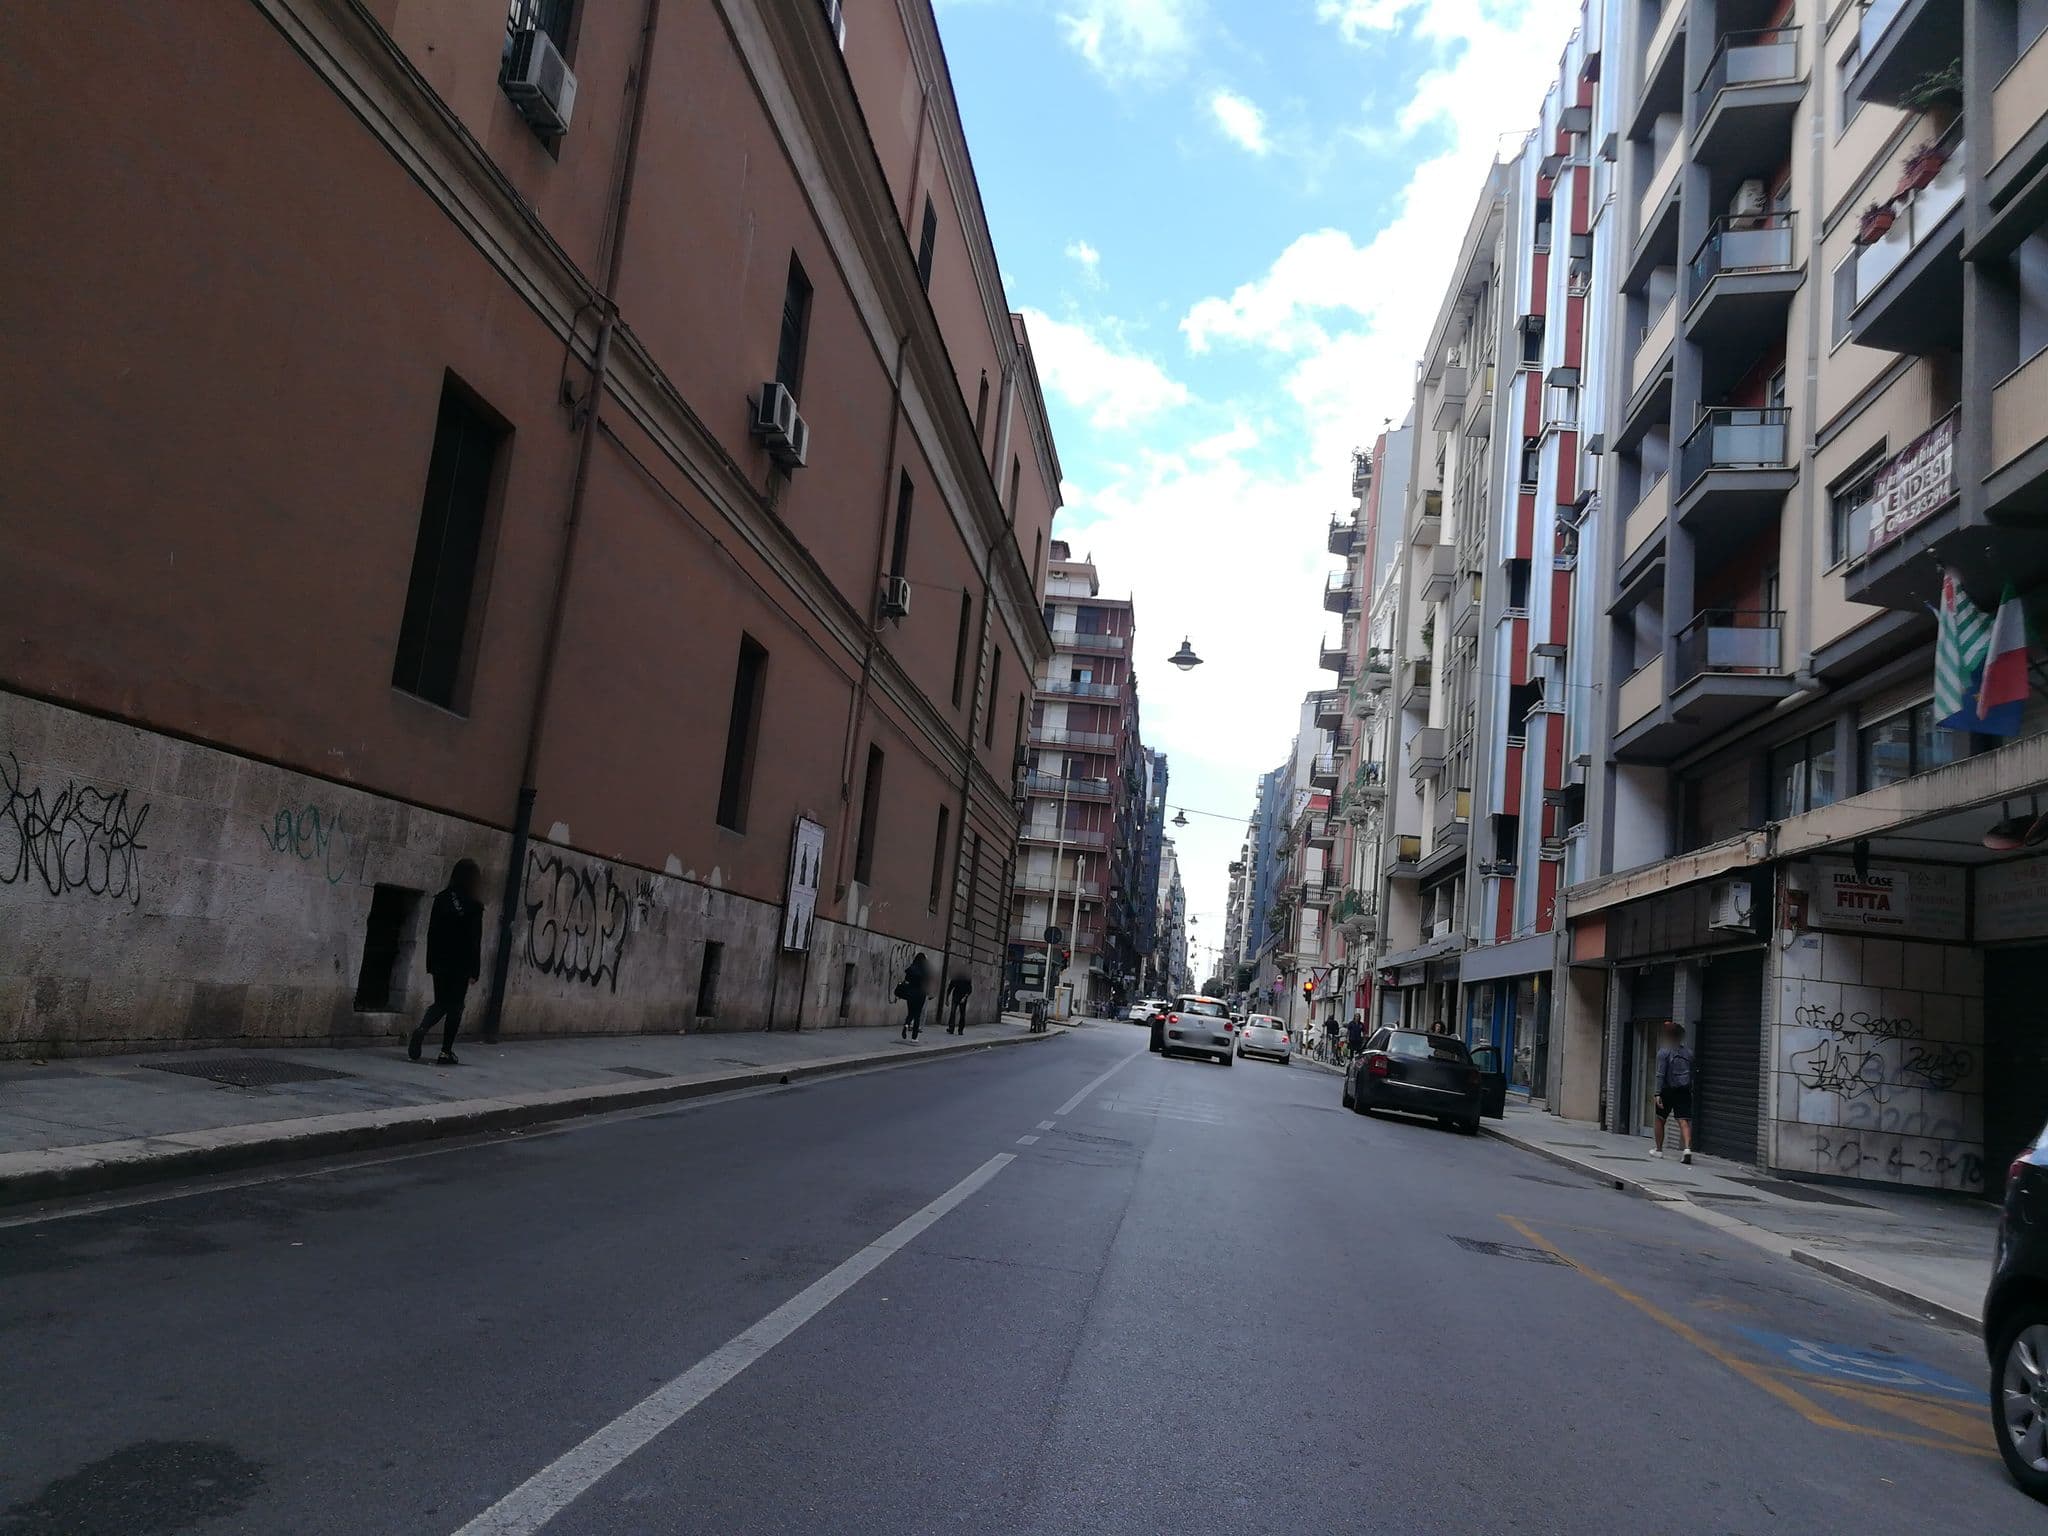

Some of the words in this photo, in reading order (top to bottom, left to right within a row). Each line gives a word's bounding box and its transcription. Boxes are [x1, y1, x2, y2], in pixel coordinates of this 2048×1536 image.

[1833, 873, 1858, 885] ITAL
[1867, 876, 1894, 887] CASE
[1836, 892, 1891, 911] FITTA
